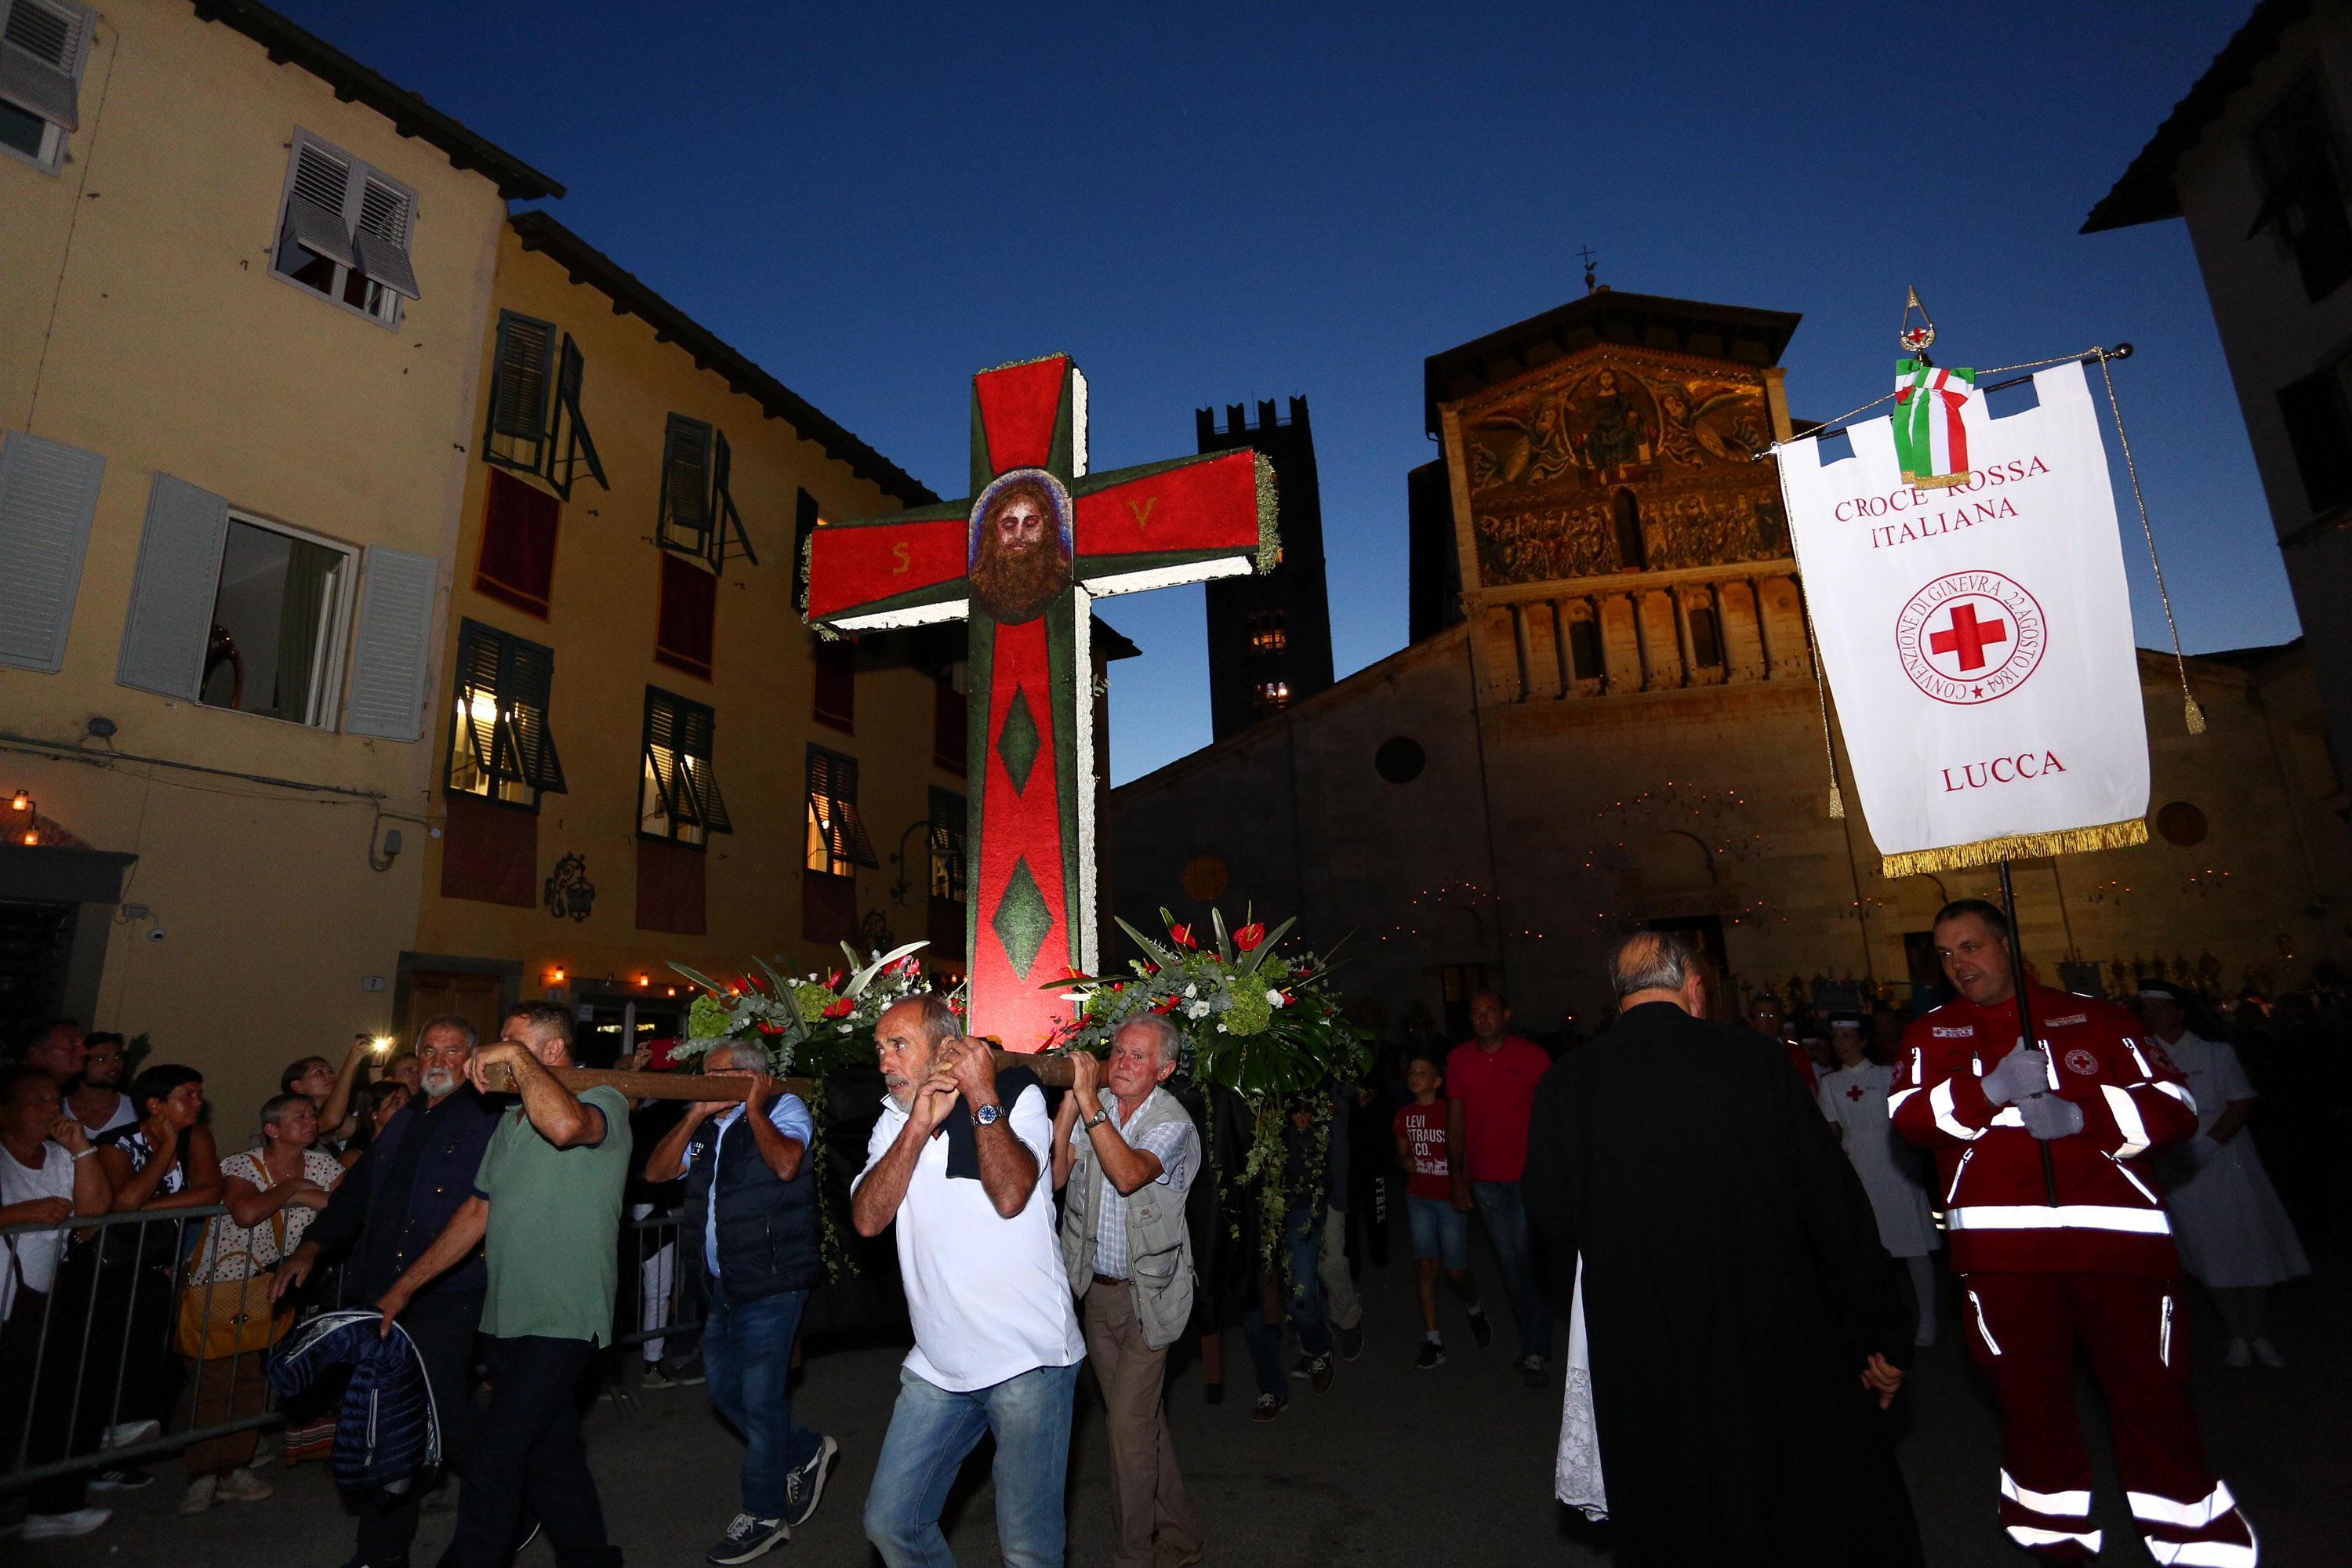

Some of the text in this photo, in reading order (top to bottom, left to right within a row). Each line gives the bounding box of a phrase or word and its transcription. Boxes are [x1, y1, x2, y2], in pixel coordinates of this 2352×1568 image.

[1124, 495, 1156, 532] V
[1835, 487, 1929, 522] CROCE
[1871, 496, 2020, 549] ITALIANA
[891, 539, 911, 576] S
[1899, 575, 2039, 700] CONVENZIONE DI GINEVRA 22 AGOSTO 1864
[1940, 750, 2067, 793] LUCCA
[1406, 1115, 1425, 1128] LEVI
[1414, 1142, 1432, 1156] CO.
